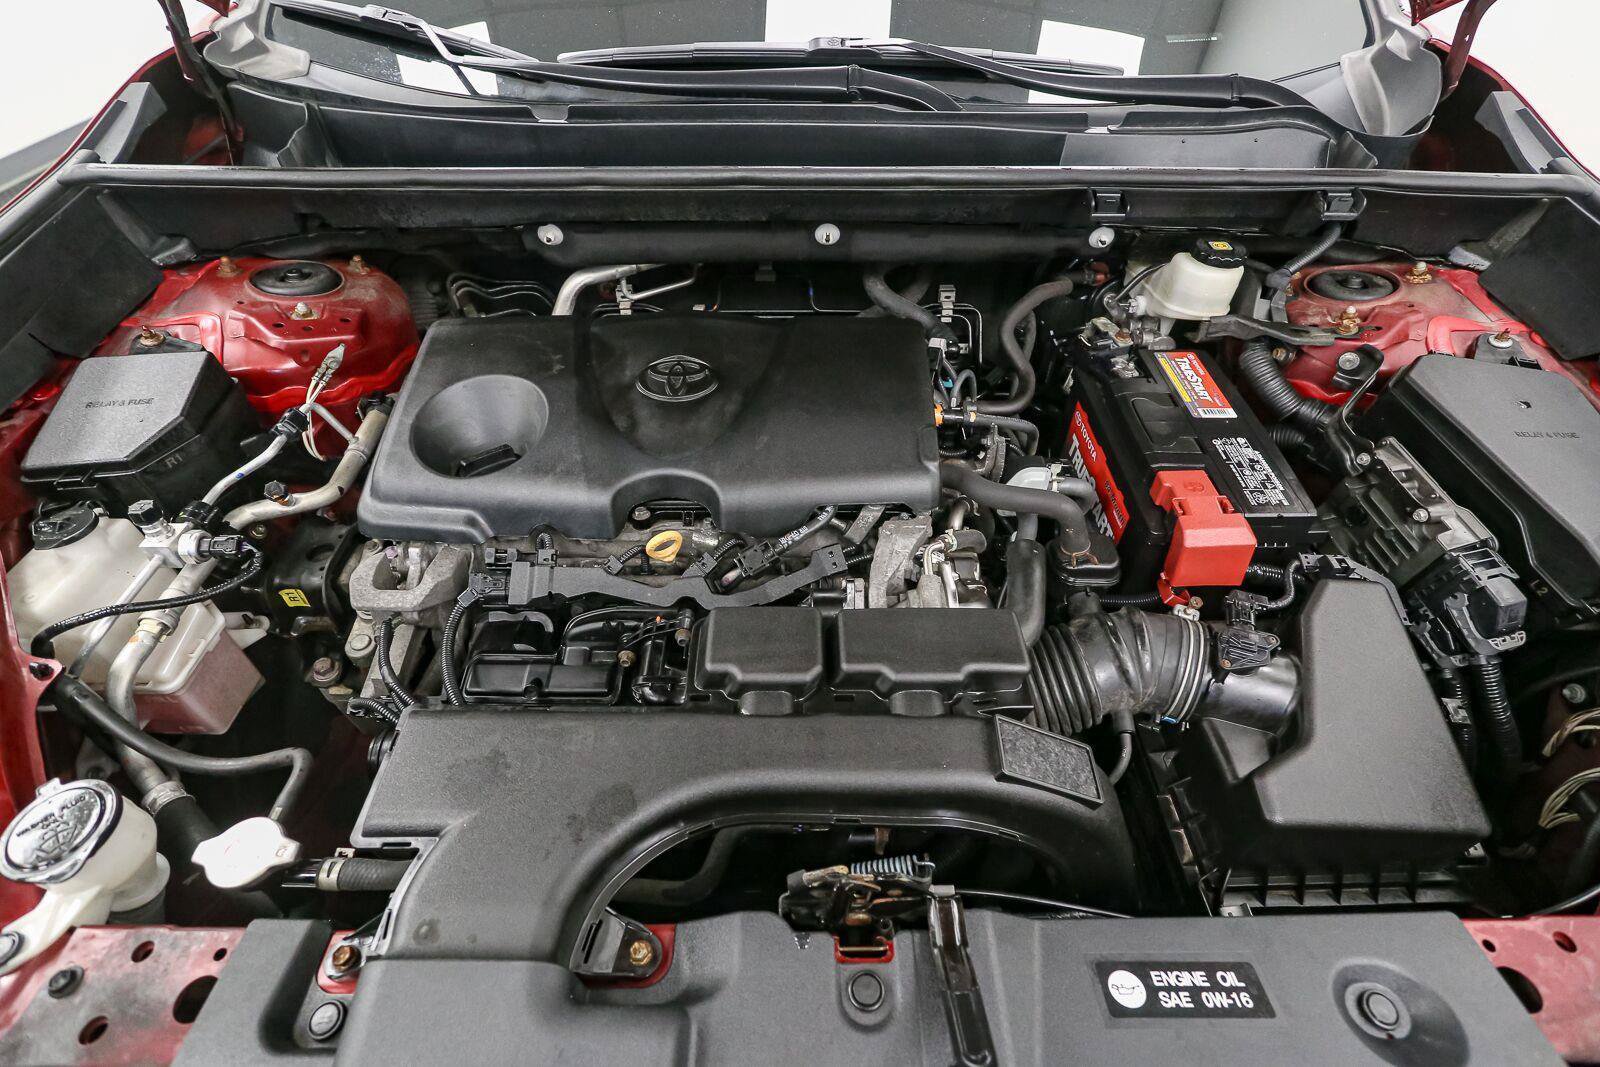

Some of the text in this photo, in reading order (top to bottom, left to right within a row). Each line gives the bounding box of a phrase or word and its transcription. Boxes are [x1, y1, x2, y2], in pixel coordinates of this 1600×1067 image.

[85, 401, 120, 409] RELAY
[128, 398, 155, 406] FUSE
[1512, 430, 1545, 438] RELAY
[1553, 431, 1581, 439] FUSE
[1079, 425, 1098, 462] TOYOTA
[1149, 970, 1246, 987] ENGINE OIL
[1157, 991, 1254, 1009] SAE 0W-16
